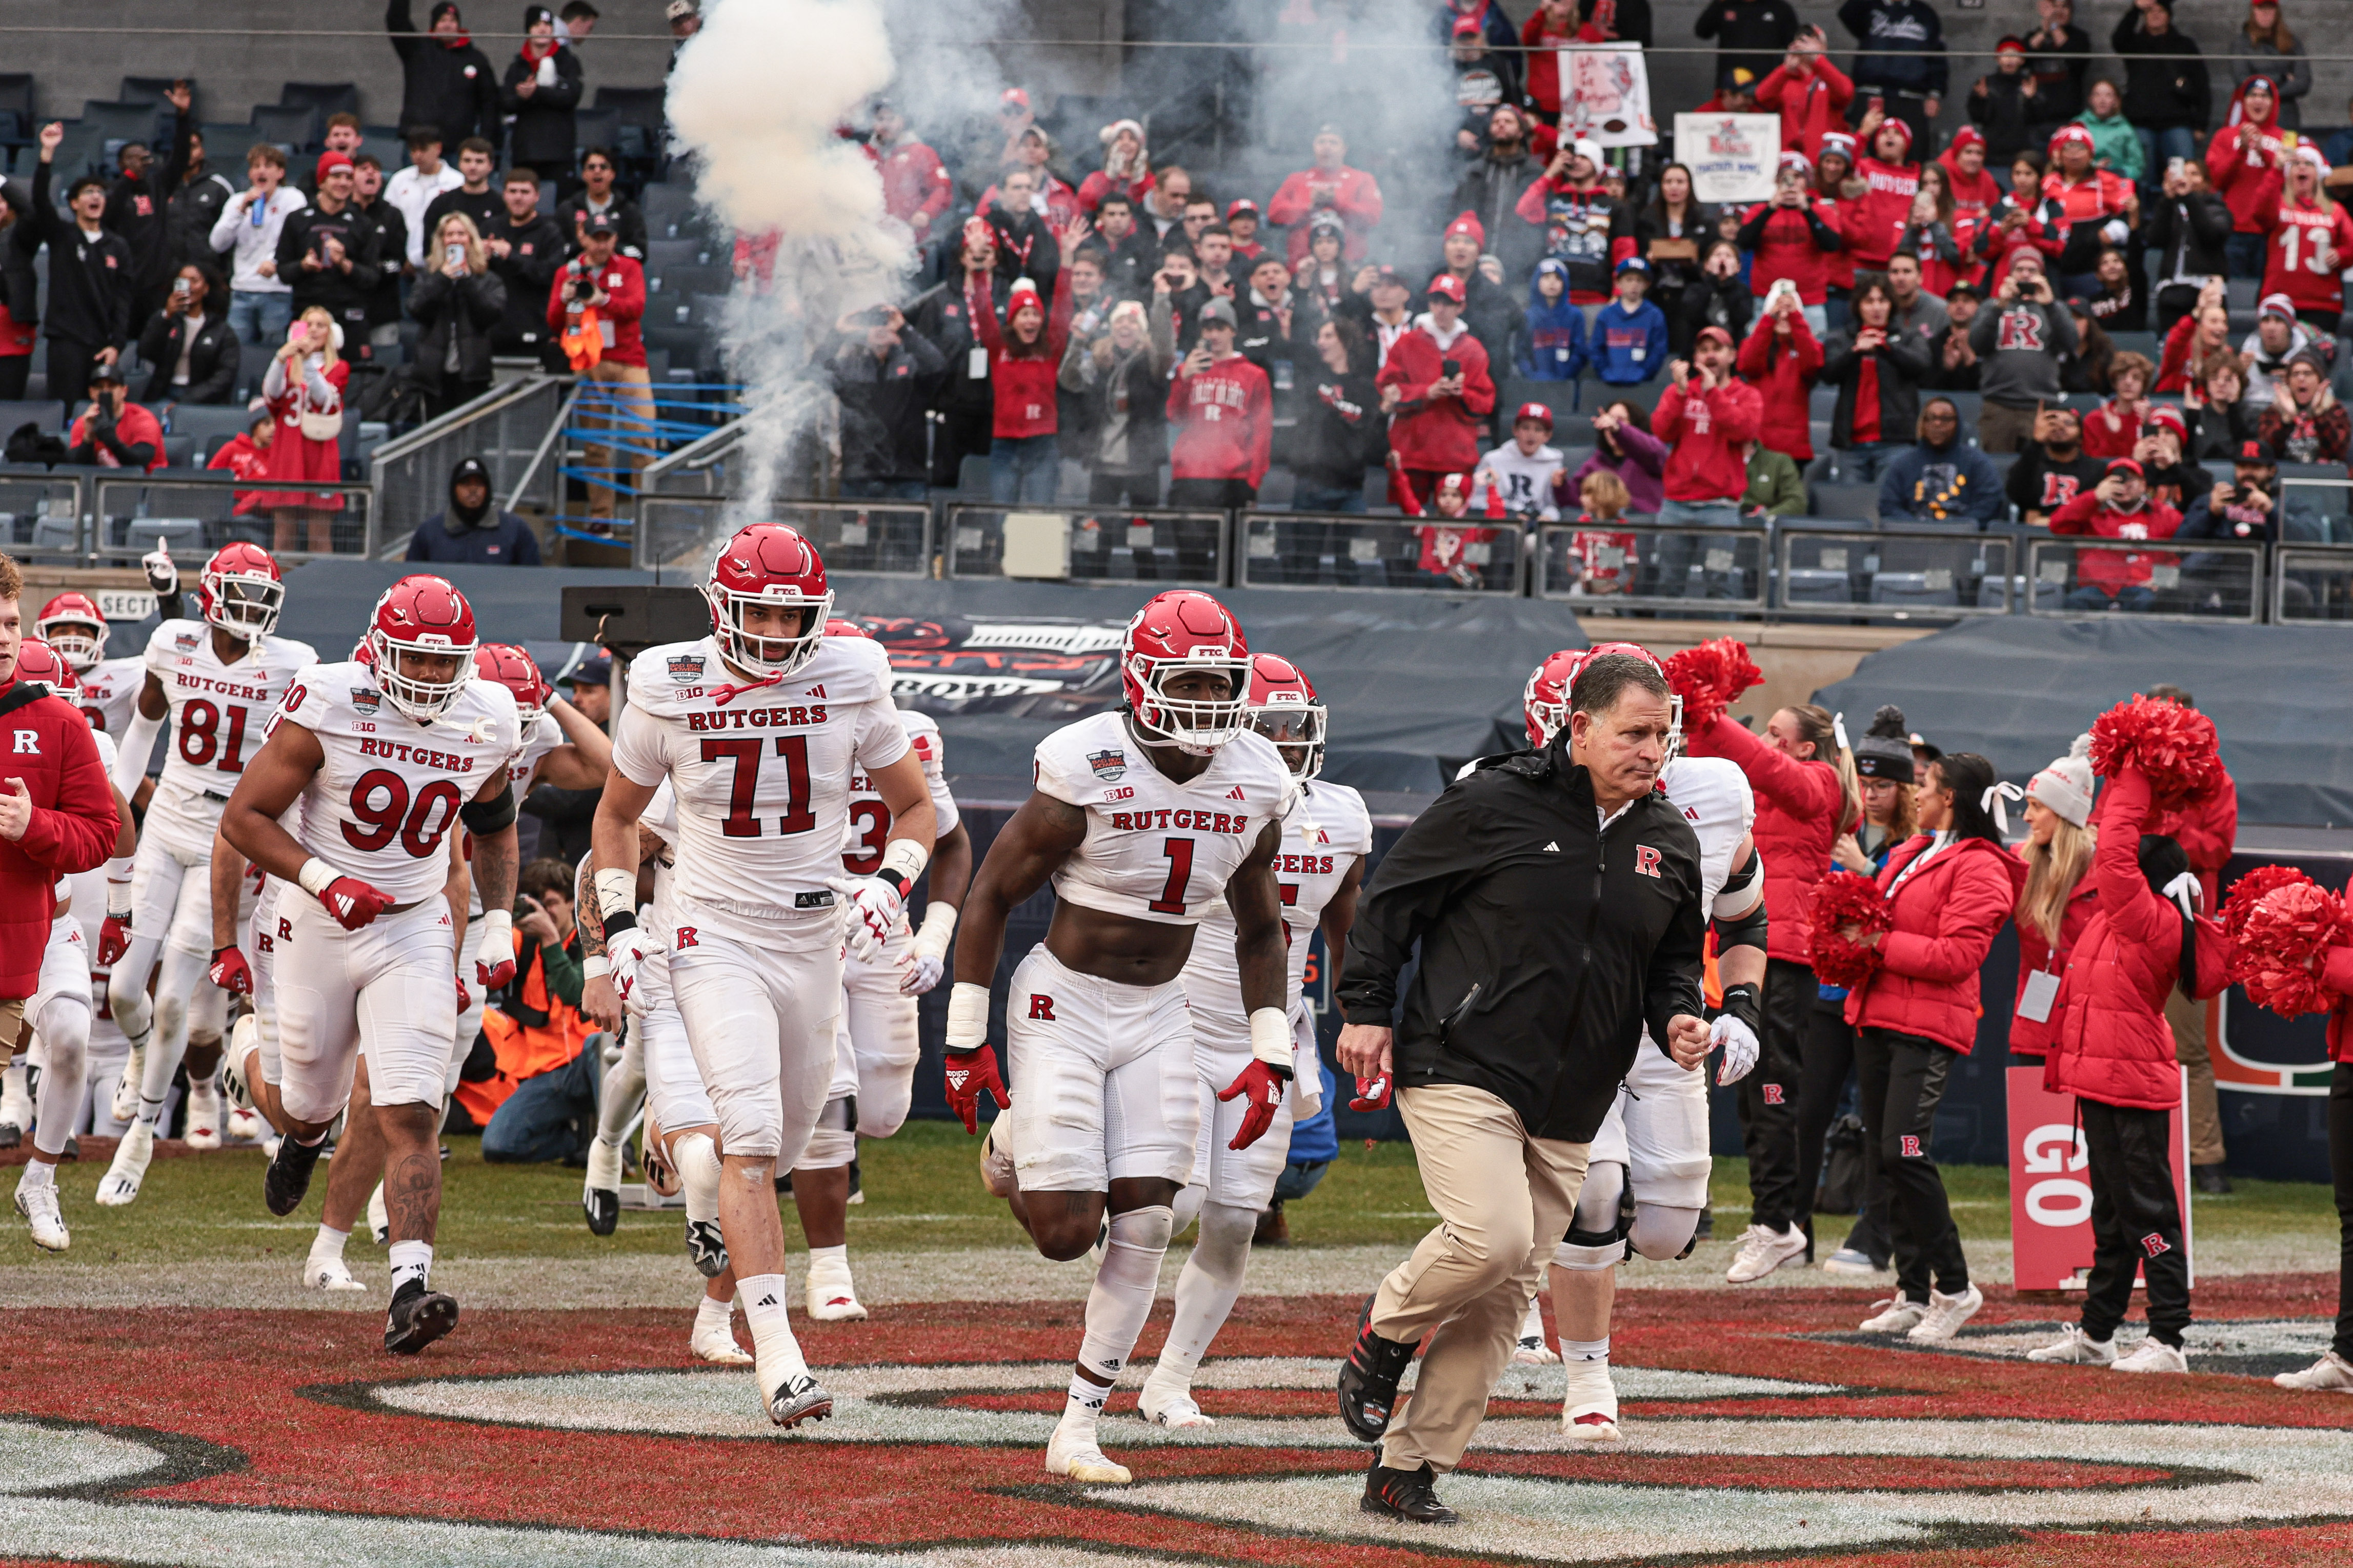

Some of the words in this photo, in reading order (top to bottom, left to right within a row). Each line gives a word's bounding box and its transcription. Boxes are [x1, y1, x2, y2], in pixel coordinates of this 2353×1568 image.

[2279, 224, 2332, 276] 13
[1996, 310, 2044, 351] R
[2040, 472, 2080, 507] R
[177, 673, 268, 701] RUTGERS
[687, 704, 828, 731] RUTGERS
[12, 729, 42, 755] R
[179, 698, 248, 773] 81
[360, 737, 474, 772] RUTGERS
[700, 734, 817, 838] 71
[340, 769, 461, 859] 90
[1112, 808, 1249, 834] RUTGERS
[1271, 854, 1334, 873] GERS
[1635, 844, 1662, 879] R
[1148, 837, 1195, 916] 1
[259, 932, 273, 953] R
[277, 916, 293, 942] R
[676, 926, 699, 951] R
[1028, 993, 1056, 1021] R
[946, 1070, 970, 1078] adidas
[1762, 1083, 1785, 1105] R
[1900, 1135, 1924, 1157] R
[2023, 1123, 2094, 1228] GO
[2140, 1232, 2171, 1258] R
[1099, 1361, 1121, 1371] adidas
